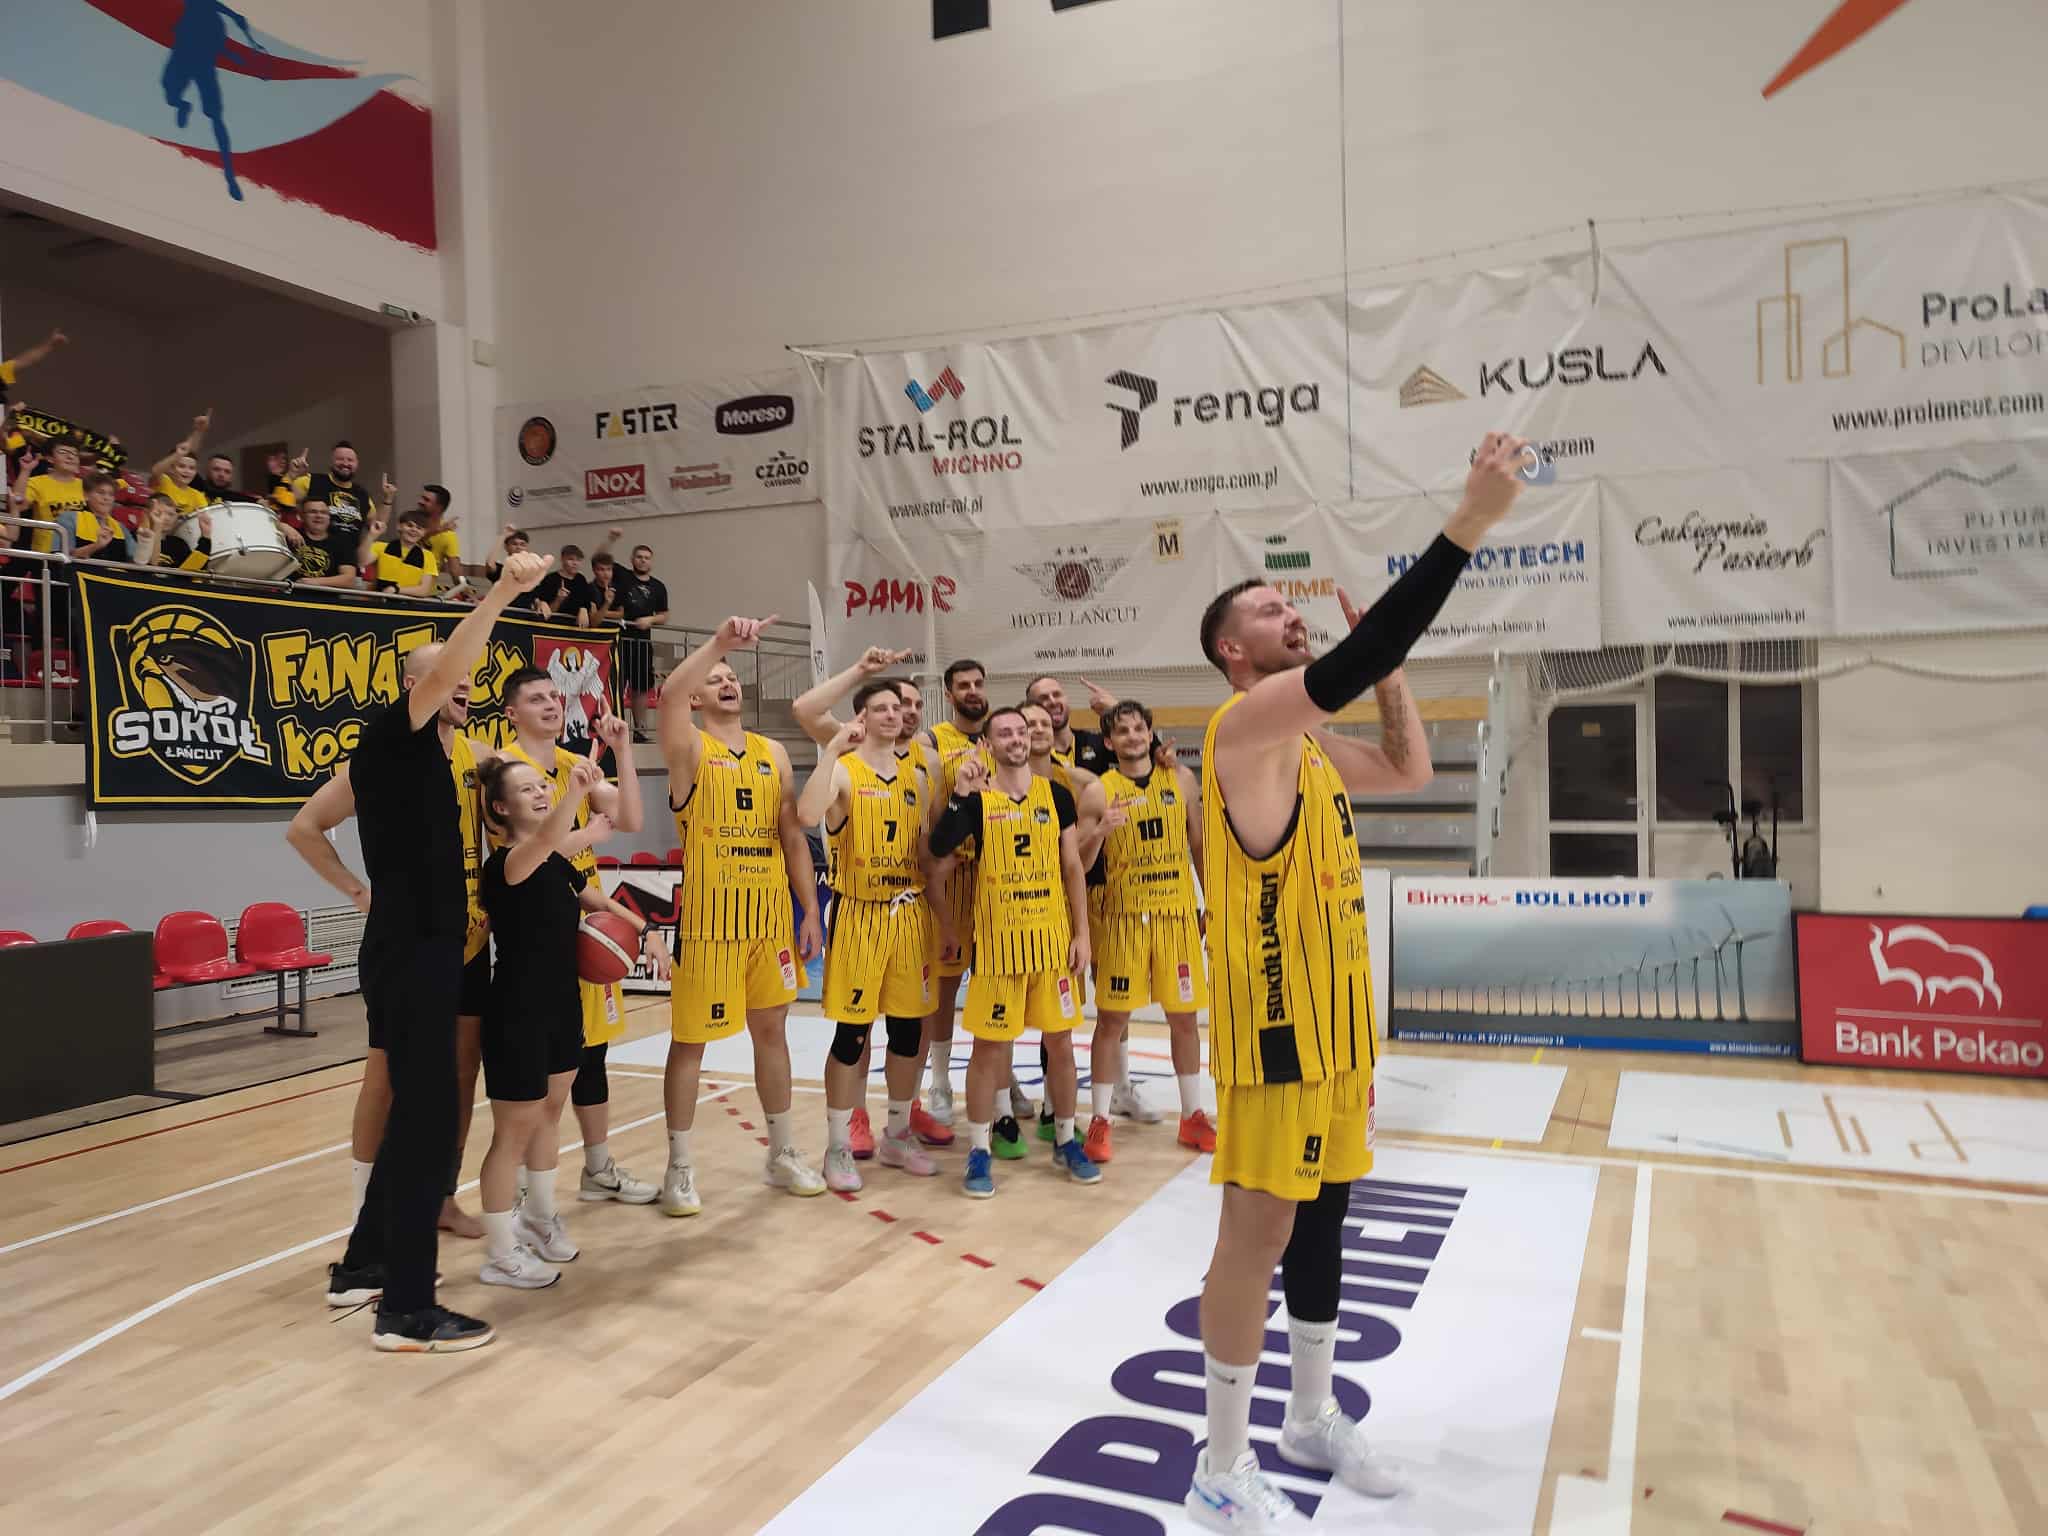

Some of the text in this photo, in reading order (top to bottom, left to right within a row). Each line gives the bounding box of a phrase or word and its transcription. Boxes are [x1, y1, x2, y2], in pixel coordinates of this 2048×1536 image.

[1174, 382, 1320, 427] renga
[596, 403, 679, 439] FASTER
[722, 406, 787, 428] Moreso
[857, 414, 1022, 458] STAL-ROL
[755, 460, 810, 479] CZADO
[932, 451, 1022, 477] MICHNO
[587, 469, 641, 495] INOX
[1140, 465, 1278, 497] www.renga.com.pl
[1158, 532, 1180, 556] M
[1010, 610, 1064, 630] HOTEL
[115, 701, 266, 759] SOKÓŁ
[165, 745, 224, 761] ŁAŃCUT
[735, 788, 753, 811] 6
[883, 820, 897, 843] 7
[1137, 817, 1164, 841] 10
[1013, 834, 1031, 857] 2
[1110, 976, 1129, 992] 10
[852, 988, 863, 1005] 7
[712, 1003, 725, 1020] 6
[992, 1003, 1006, 1020] 2
[1835, 1020, 2045, 1068] Bank Pekao
